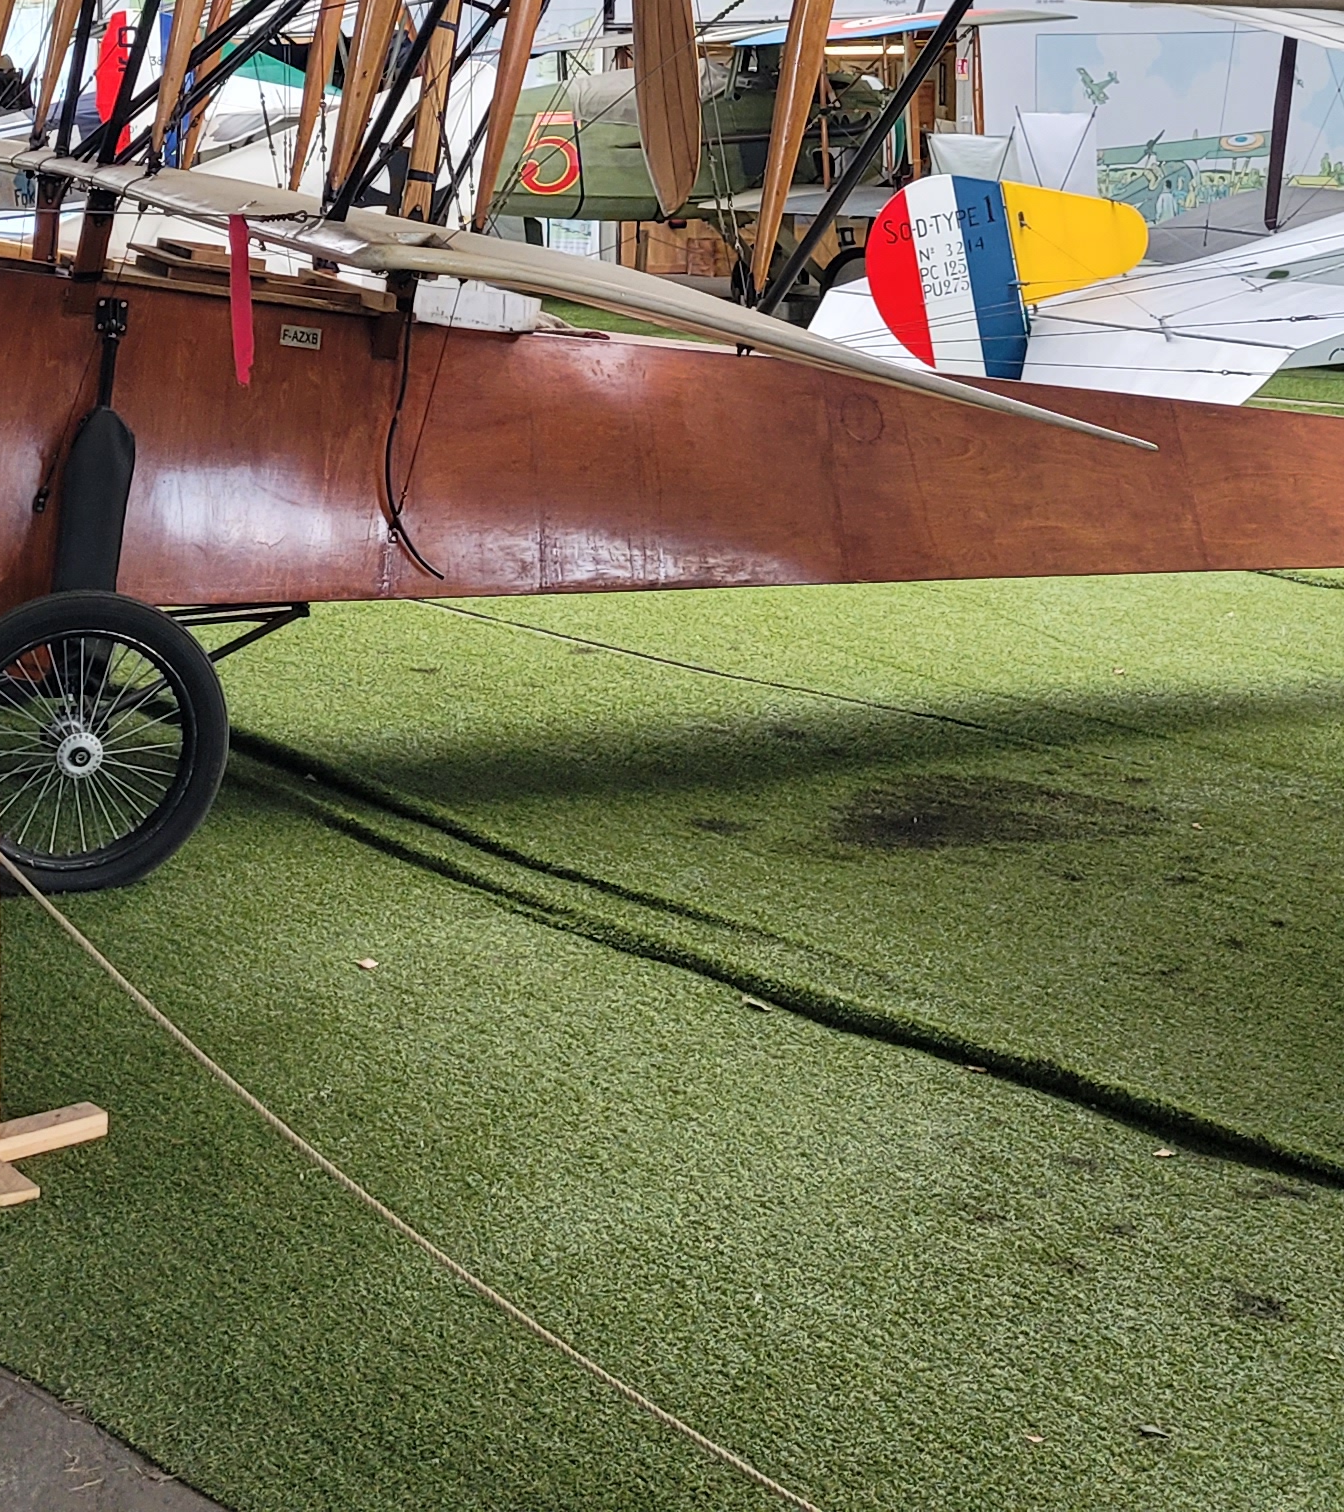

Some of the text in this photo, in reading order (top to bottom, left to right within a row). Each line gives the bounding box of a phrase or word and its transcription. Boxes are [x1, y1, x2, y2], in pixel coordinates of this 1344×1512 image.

[519, 111, 582, 196] 5
[983, 194, 997, 224] 1
[945, 236, 984, 257] 3214
[919, 257, 967, 283] PC 125
[282, 328, 319, 345] F-AZXB
